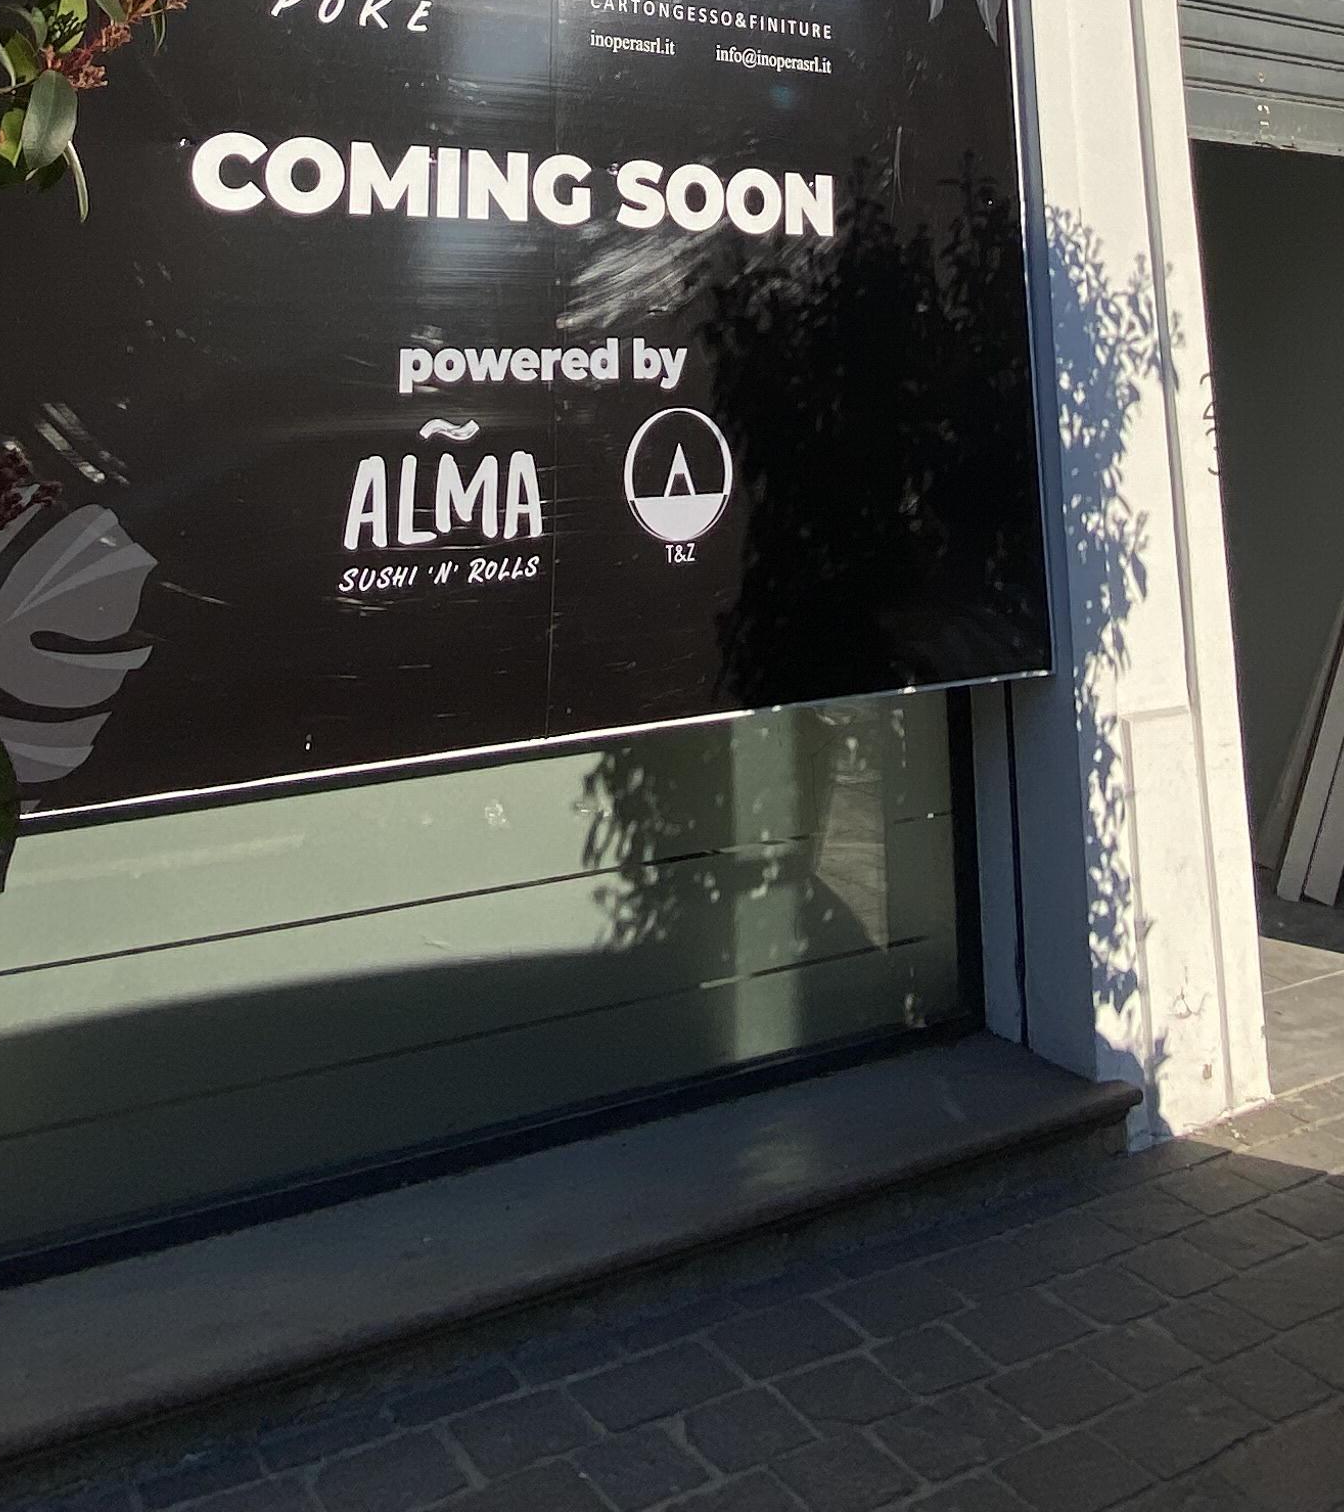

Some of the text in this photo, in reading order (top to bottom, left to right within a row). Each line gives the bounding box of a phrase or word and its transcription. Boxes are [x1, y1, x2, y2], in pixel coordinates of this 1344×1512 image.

[589, 29, 833, 75] inoperasrl.it info@inoperasrl.it
[191, 131, 835, 237] COMING SOON
[399, 337, 688, 394] powered by
[343, 450, 543, 550] ALMA
[338, 555, 541, 592] SUSHI 'N' ROLLS
[665, 543, 696, 564] T&Z
